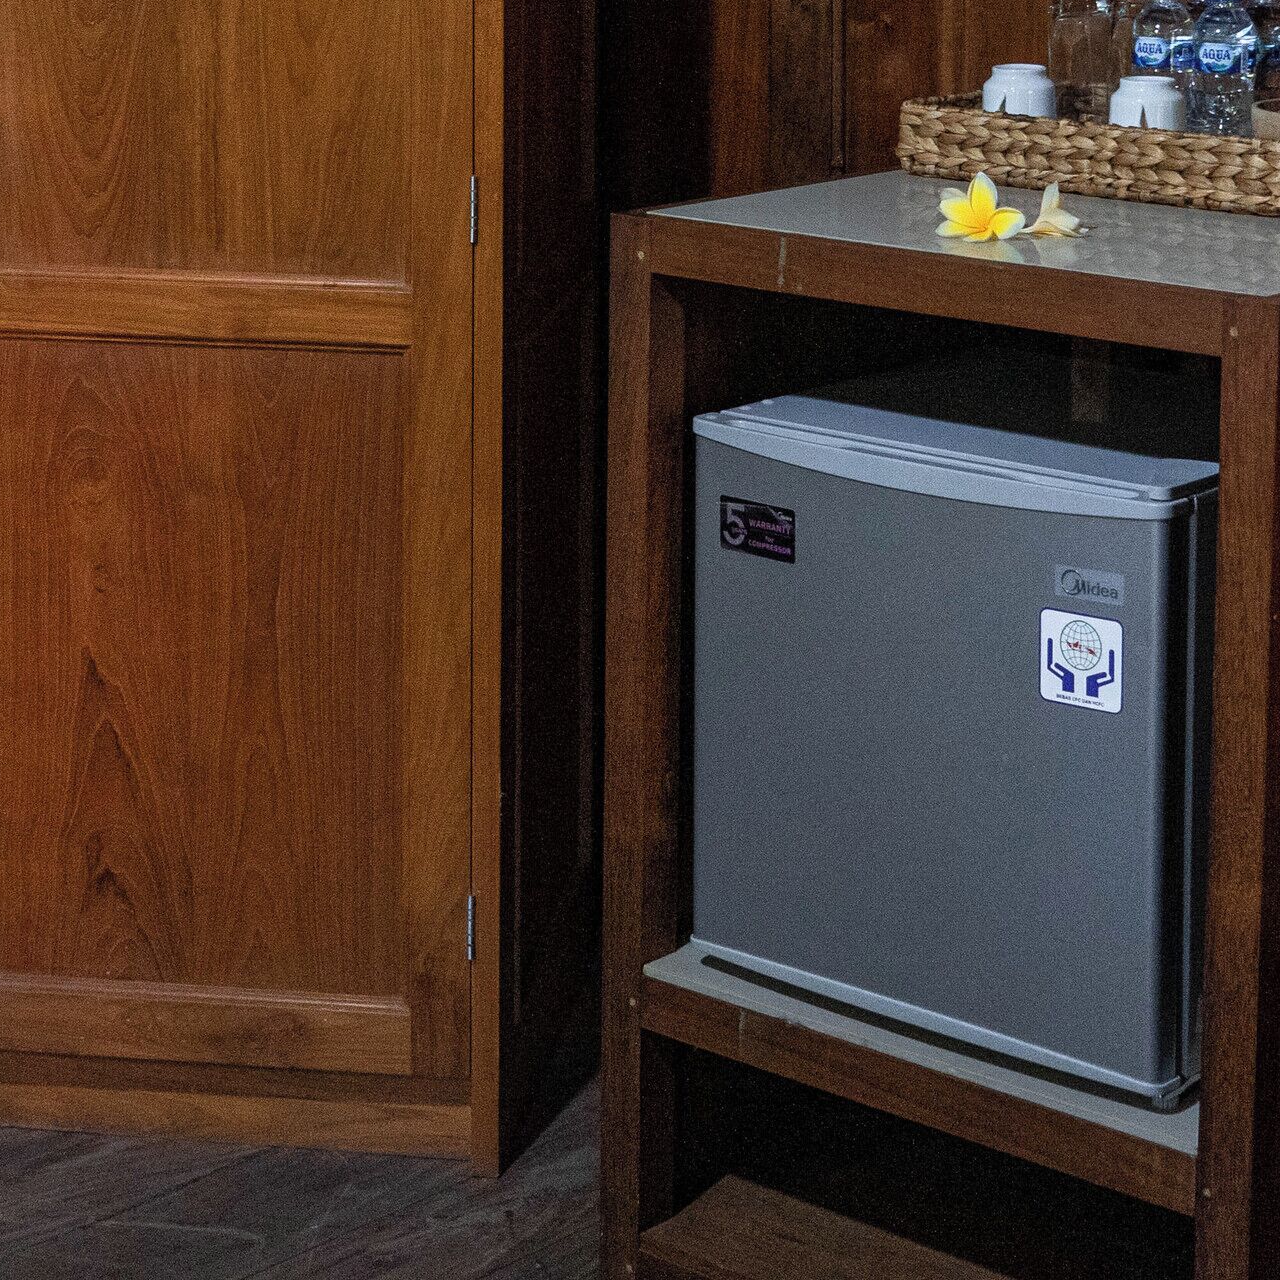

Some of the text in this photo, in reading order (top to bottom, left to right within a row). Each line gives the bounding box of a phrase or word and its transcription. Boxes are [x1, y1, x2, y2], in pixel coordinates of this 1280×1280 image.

[1137, 42, 1163, 57] AQUA
[1201, 48, 1231, 62] AQUA
[723, 503, 745, 546] 5
[748, 518, 791, 535] WARRANTY
[748, 539, 792, 556] COMPRESSOR
[1066, 575, 1119, 599] Midea
